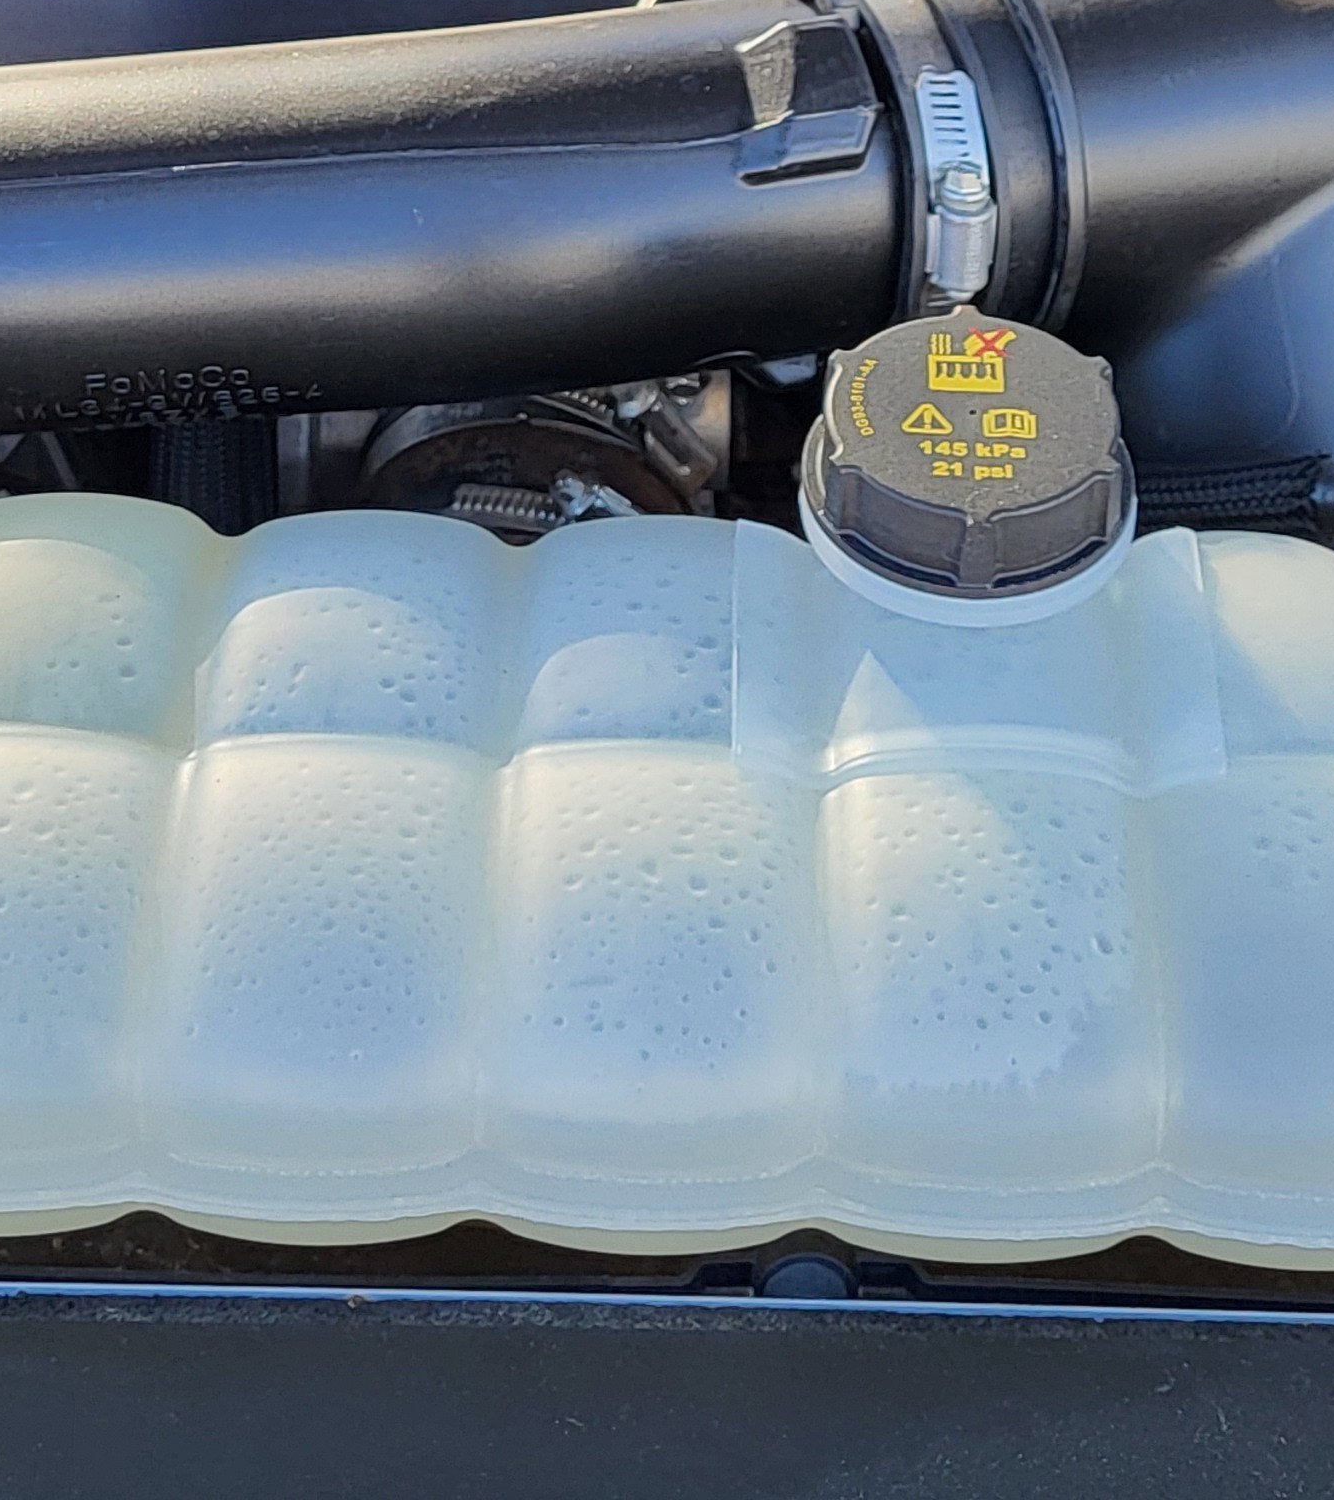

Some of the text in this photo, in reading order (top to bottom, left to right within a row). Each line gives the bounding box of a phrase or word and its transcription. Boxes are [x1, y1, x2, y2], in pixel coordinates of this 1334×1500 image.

[84, 365, 251, 396] FoMoCo
[919, 440, 1027, 459] 145 kPa
[931, 461, 1014, 481] 21 psi
